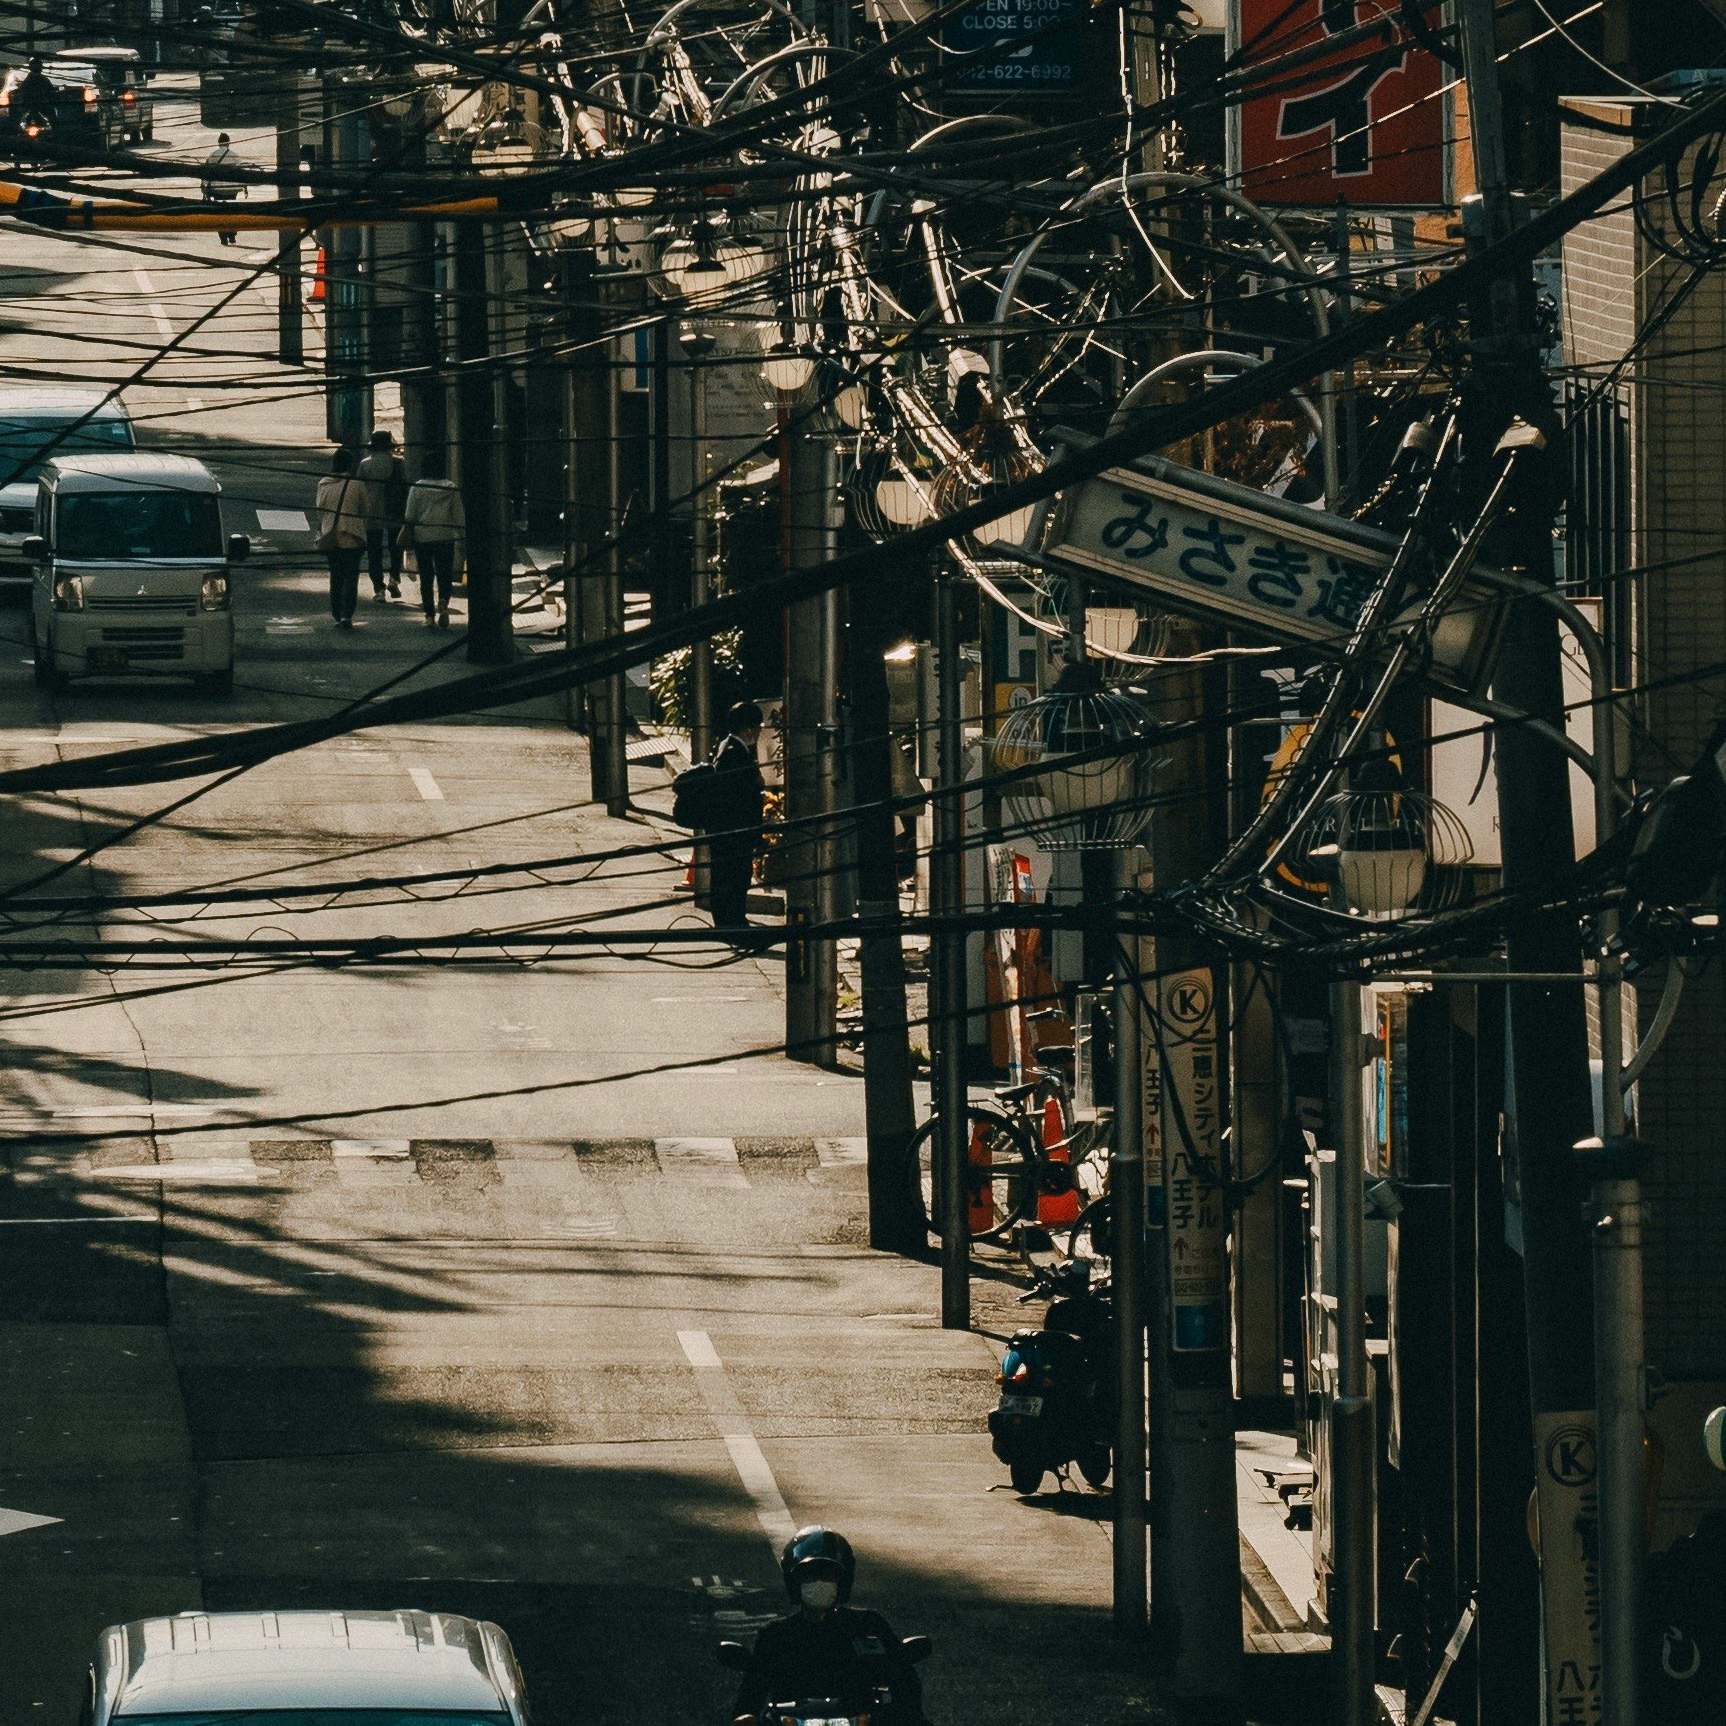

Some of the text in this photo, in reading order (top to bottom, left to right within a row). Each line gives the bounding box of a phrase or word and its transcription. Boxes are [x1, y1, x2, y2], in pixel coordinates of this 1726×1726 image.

[961, 15, 1018, 30] CLOSE
[956, 64, 1073, 80] 2-622-6992
[1101, 492, 1374, 630] みさき通
